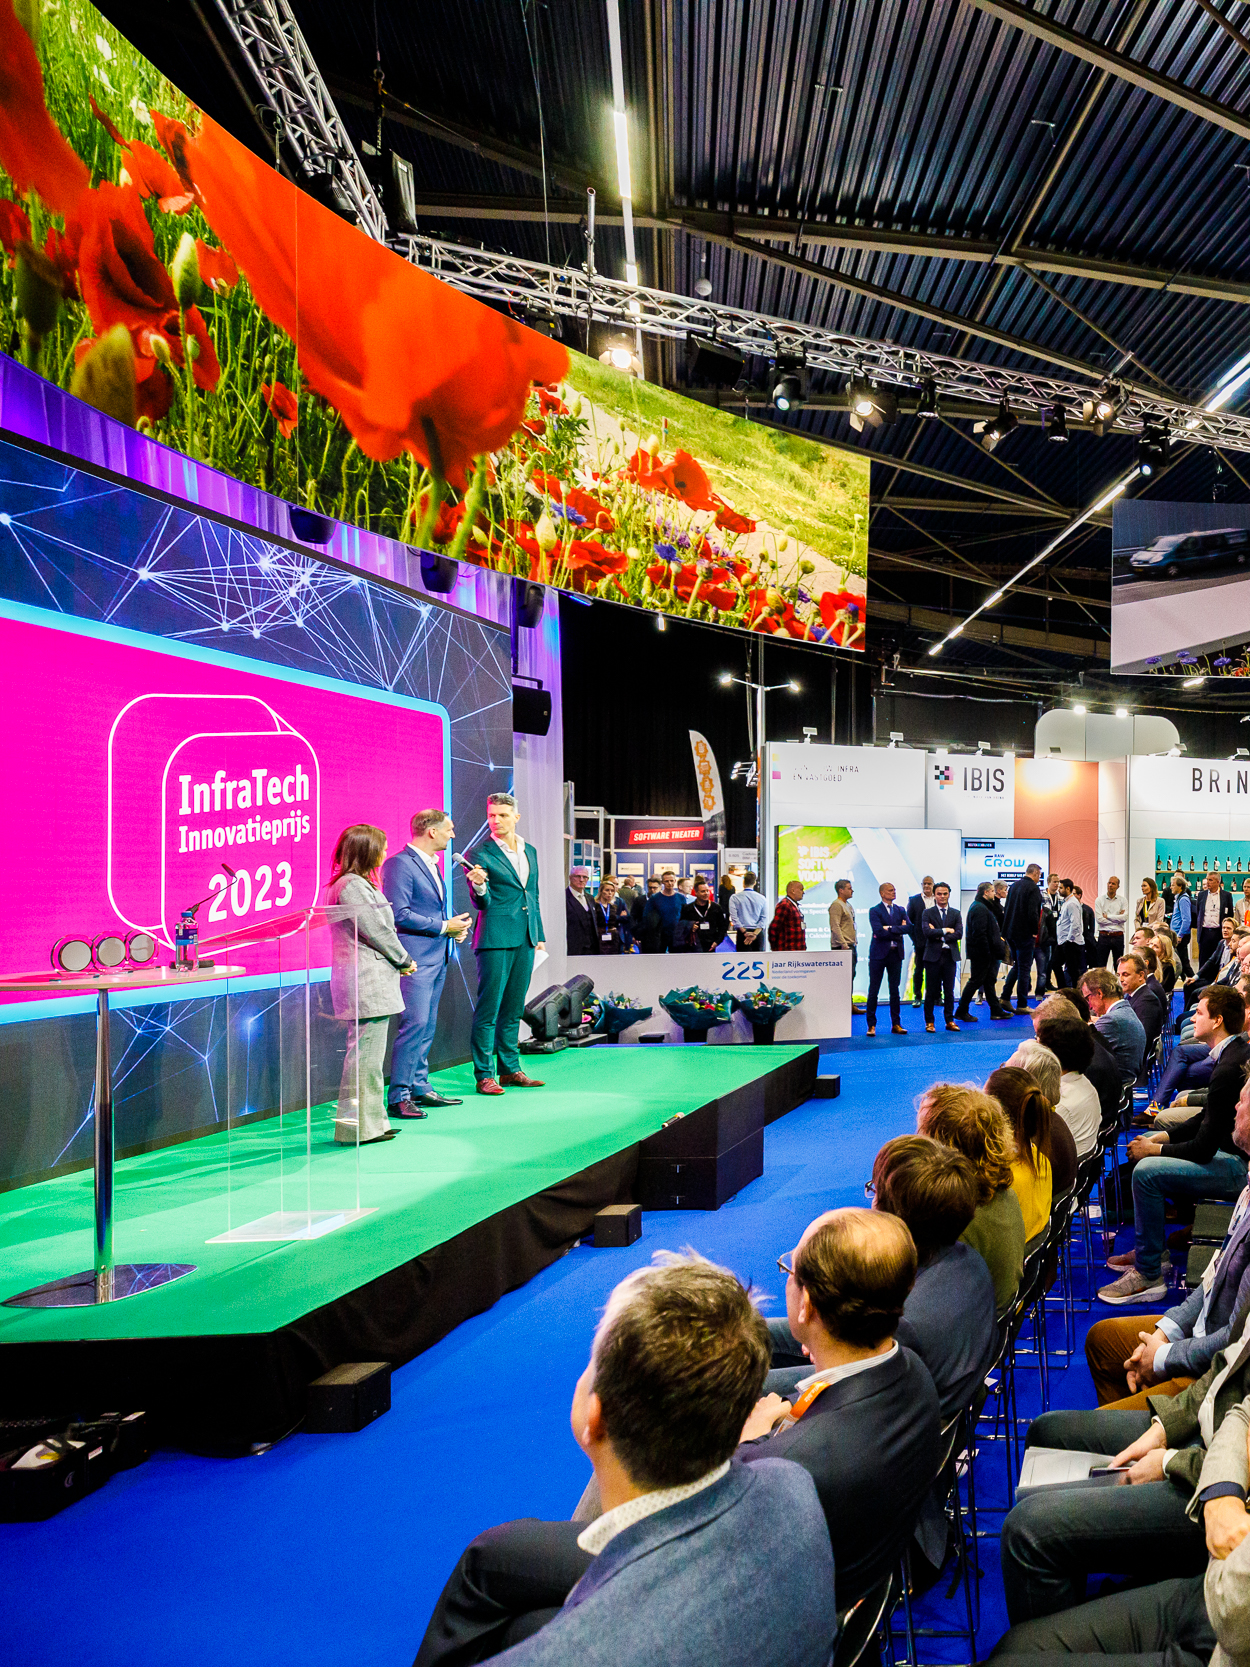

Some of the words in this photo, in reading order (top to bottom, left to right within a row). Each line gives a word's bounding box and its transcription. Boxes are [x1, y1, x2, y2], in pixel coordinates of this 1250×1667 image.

[178, 764, 310, 816] InfraTech
[963, 767, 1005, 792] IBIS
[178, 809, 311, 854] Innovatieprijs
[633, 831, 671, 842] SOFTWARE
[671, 829, 700, 840] THEATER
[984, 859, 1026, 868] CROW
[207, 861, 293, 923] 2023
[721, 961, 765, 980] 225
[771, 961, 786, 969] jaar
[787, 961, 844, 969] Rijkswaterstaat
